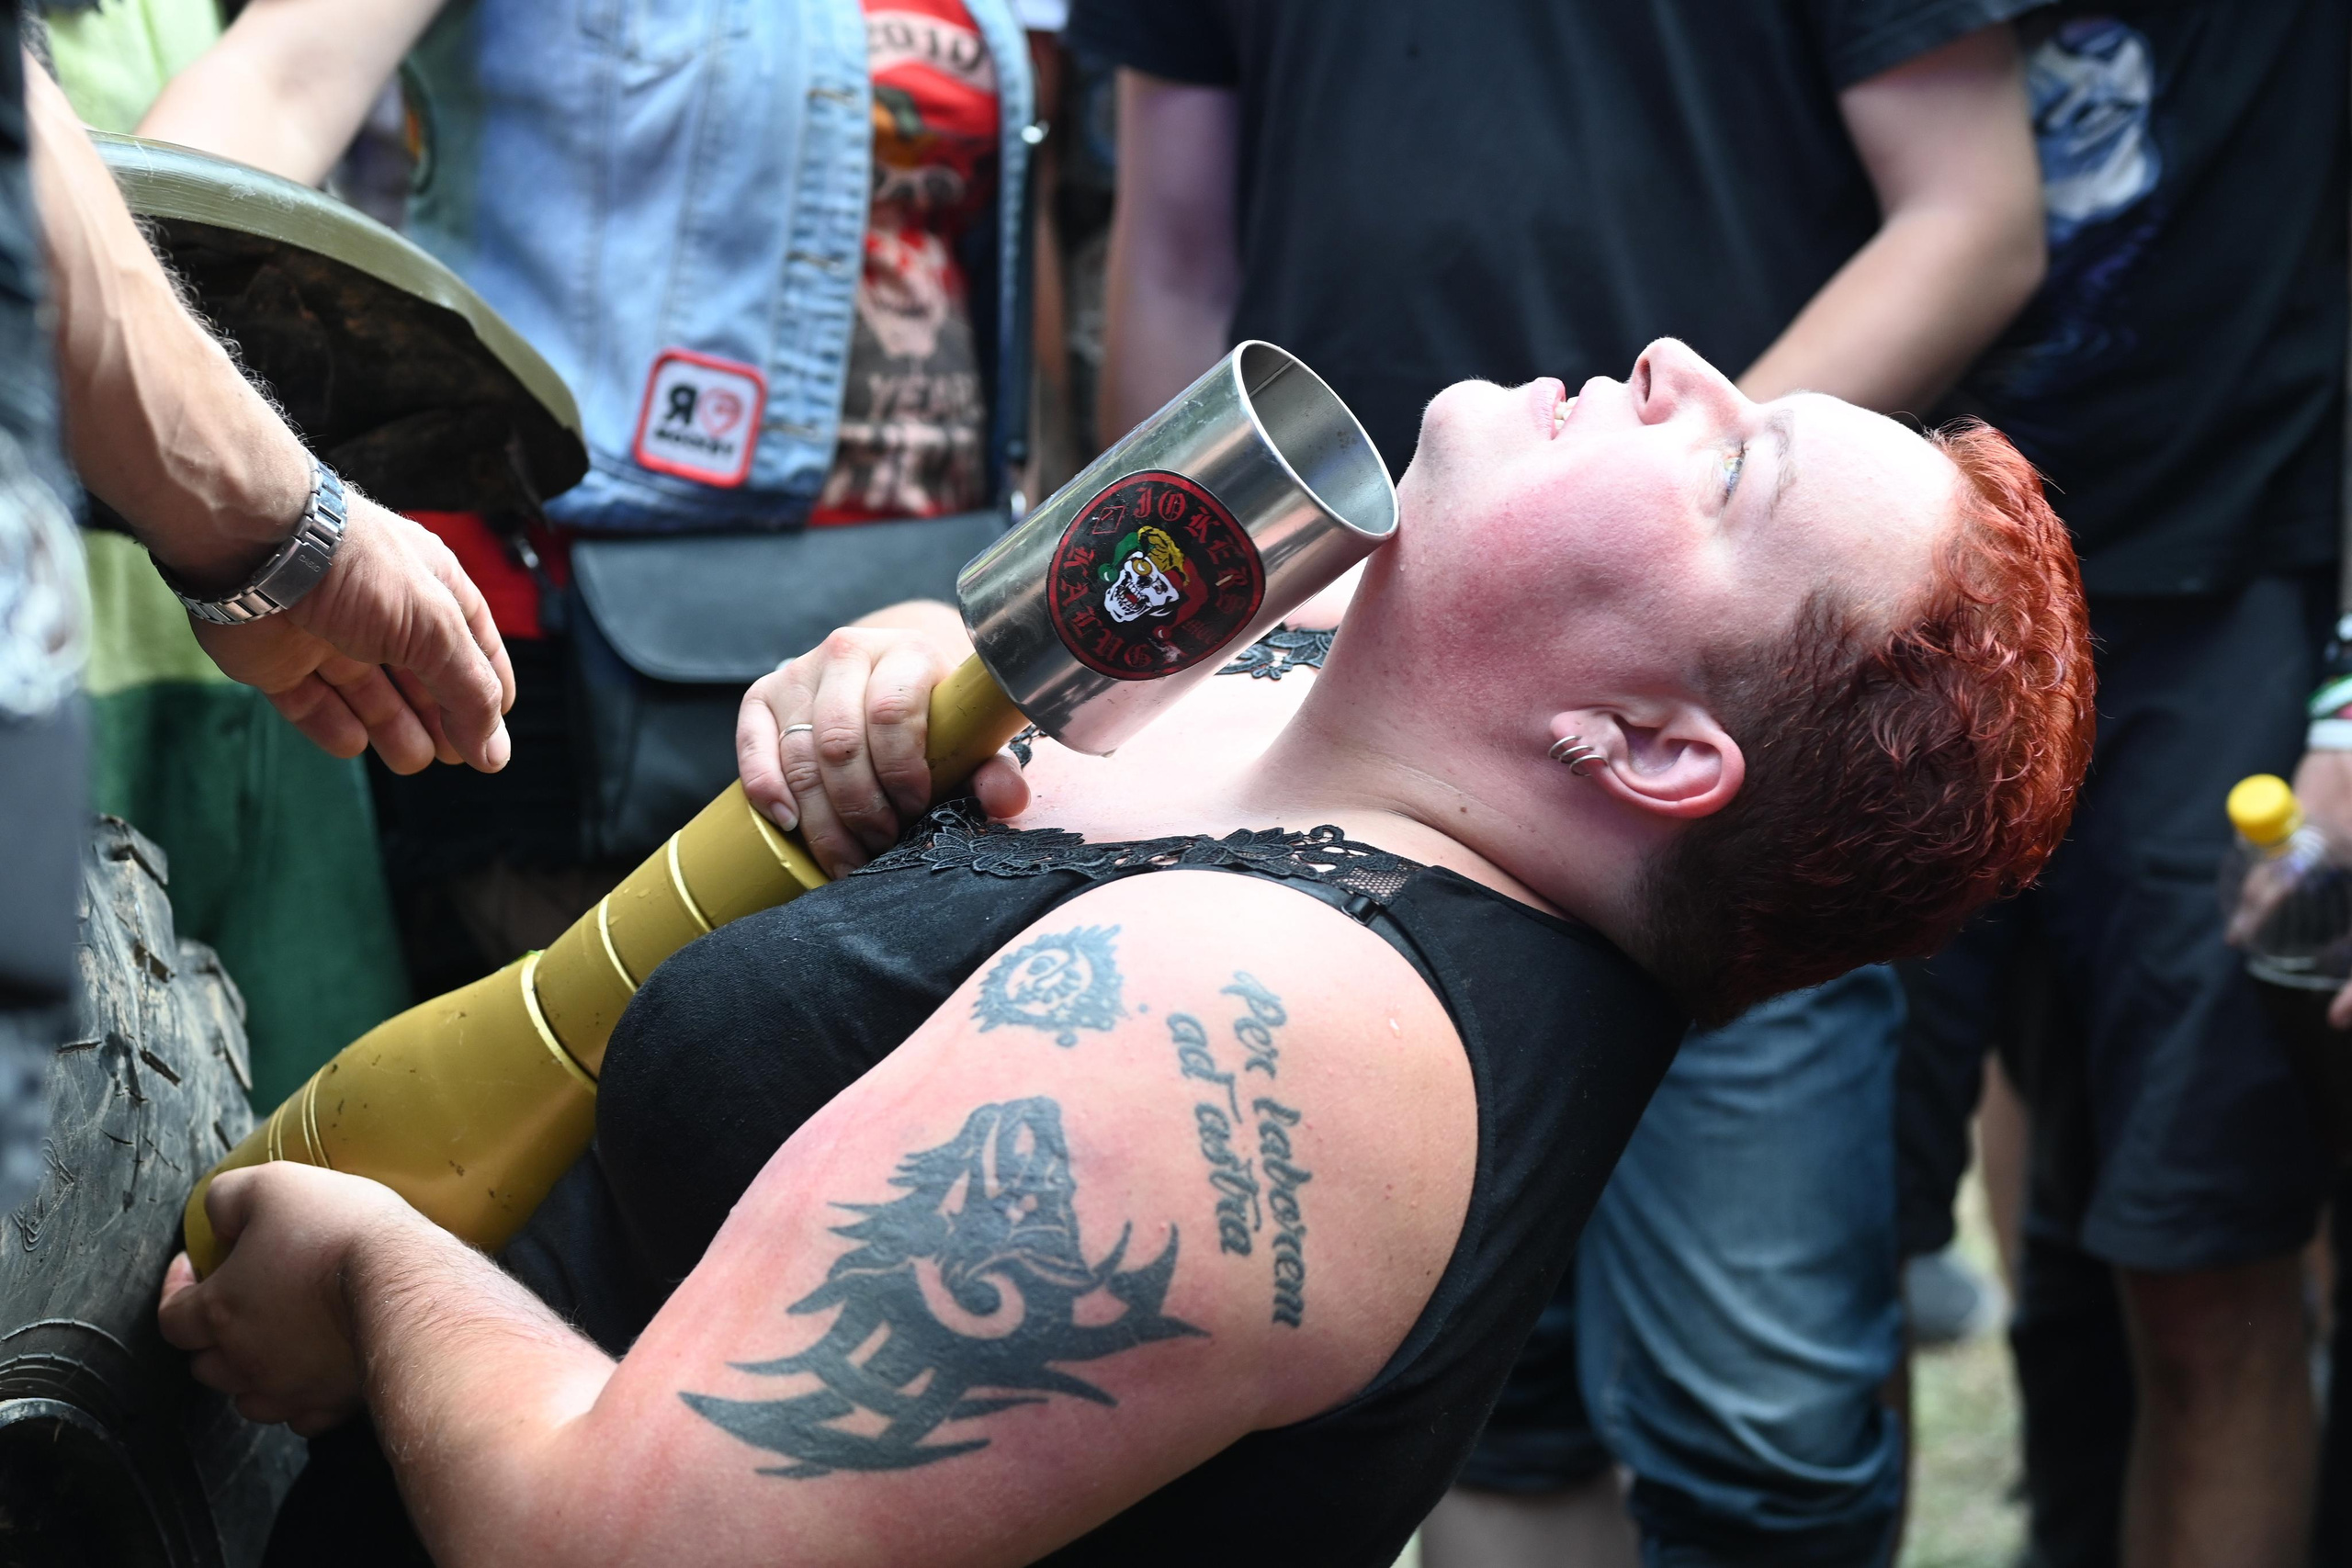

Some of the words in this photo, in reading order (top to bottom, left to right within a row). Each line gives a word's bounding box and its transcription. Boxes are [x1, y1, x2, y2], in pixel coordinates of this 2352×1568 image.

[298, 554, 321, 572] CASIO
[1134, 487, 1250, 614] JOKERS
[1167, 1012, 1242, 1124] ad
[1220, 970, 1287, 1079] Per
[1194, 1101, 1263, 1257] astra
